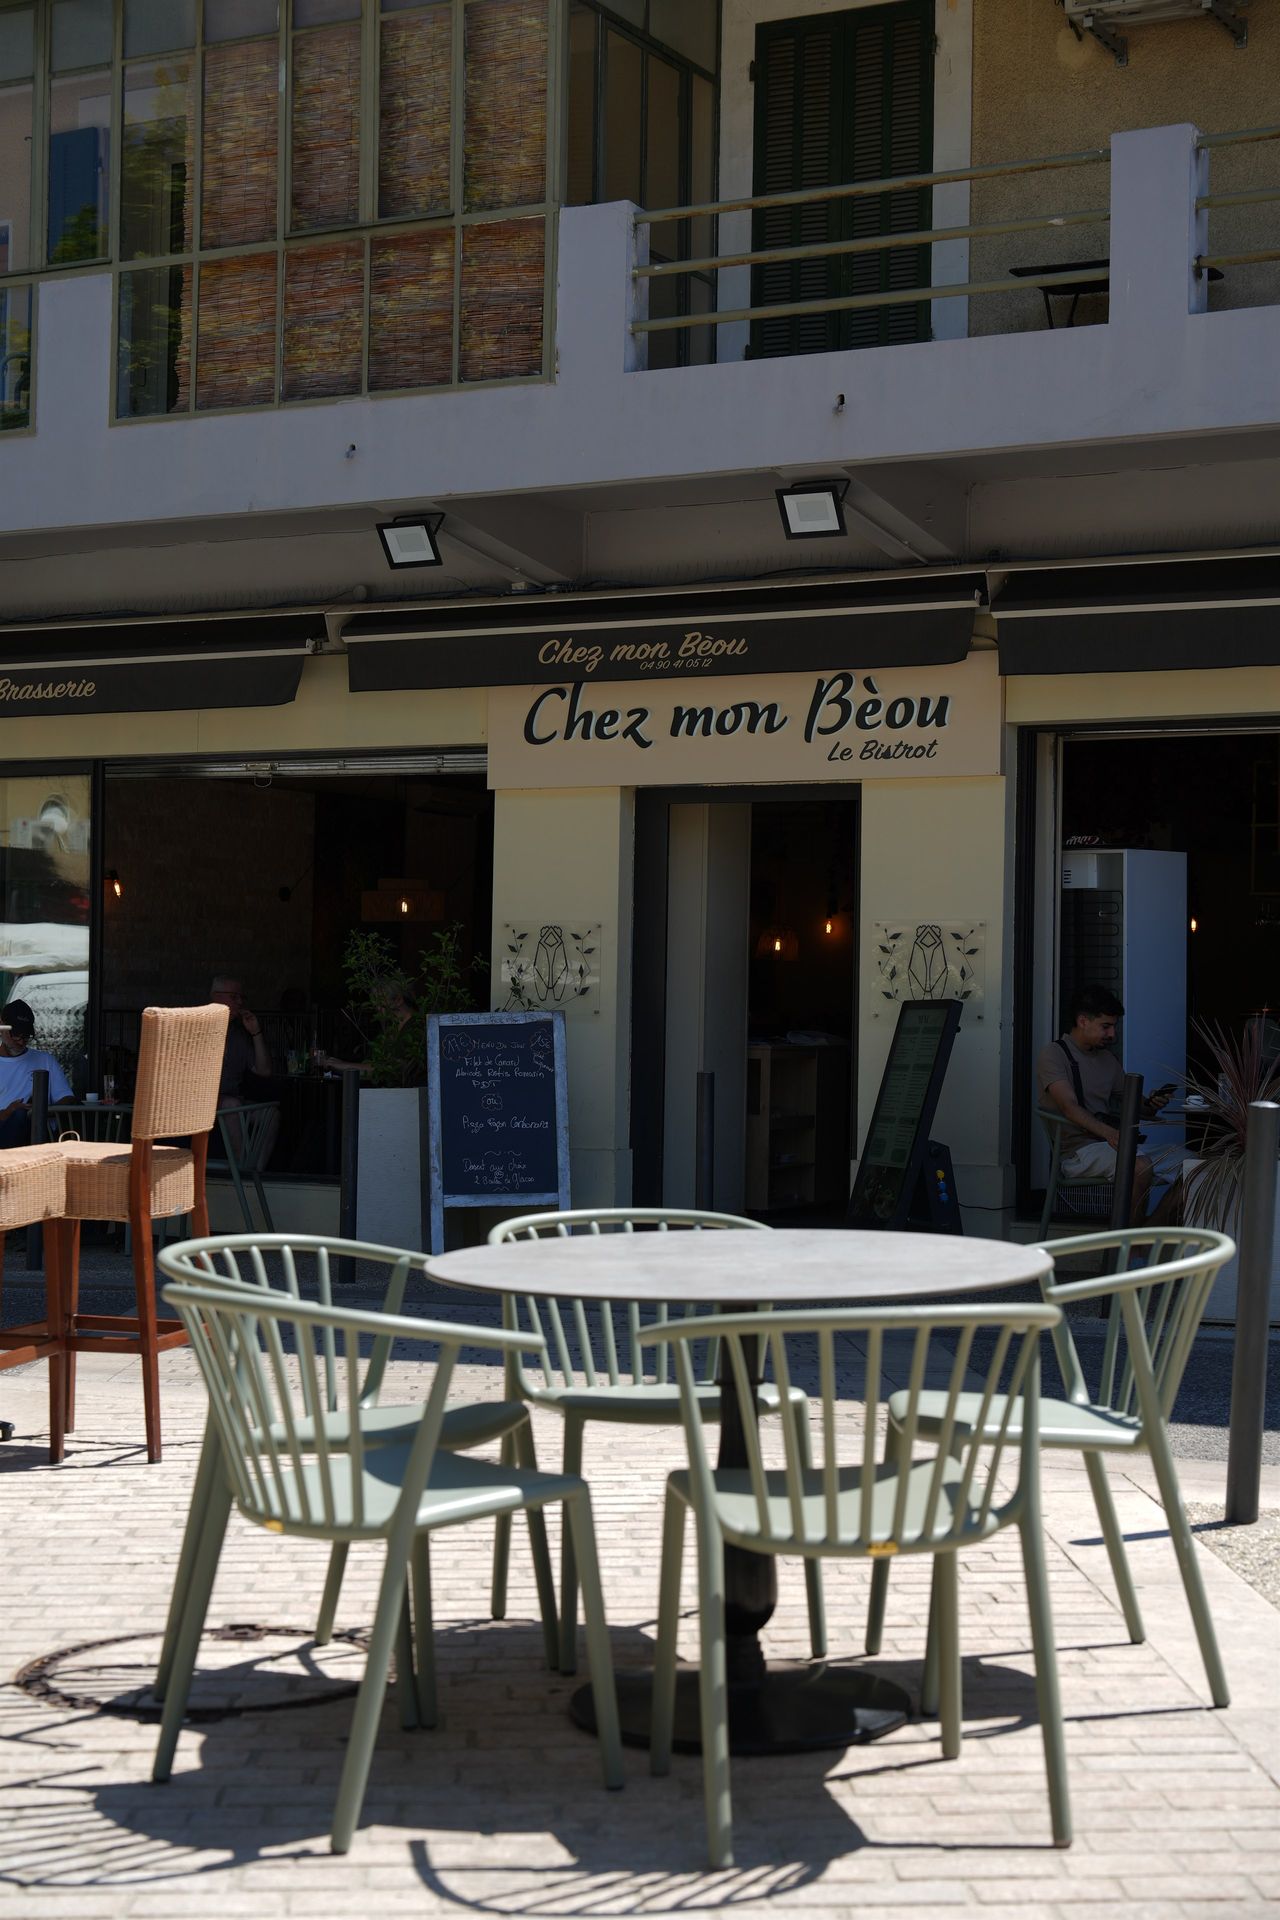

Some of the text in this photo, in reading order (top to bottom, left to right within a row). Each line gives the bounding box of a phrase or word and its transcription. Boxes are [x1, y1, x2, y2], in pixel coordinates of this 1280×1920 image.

[538, 637, 605, 672] Chez
[610, 641, 671, 661] mon
[640, 658, 713, 671] 04 90 41 05 12
[524, 672, 950, 749] Chez mon Bèou
[827, 739, 938, 762] Le Bistrot
